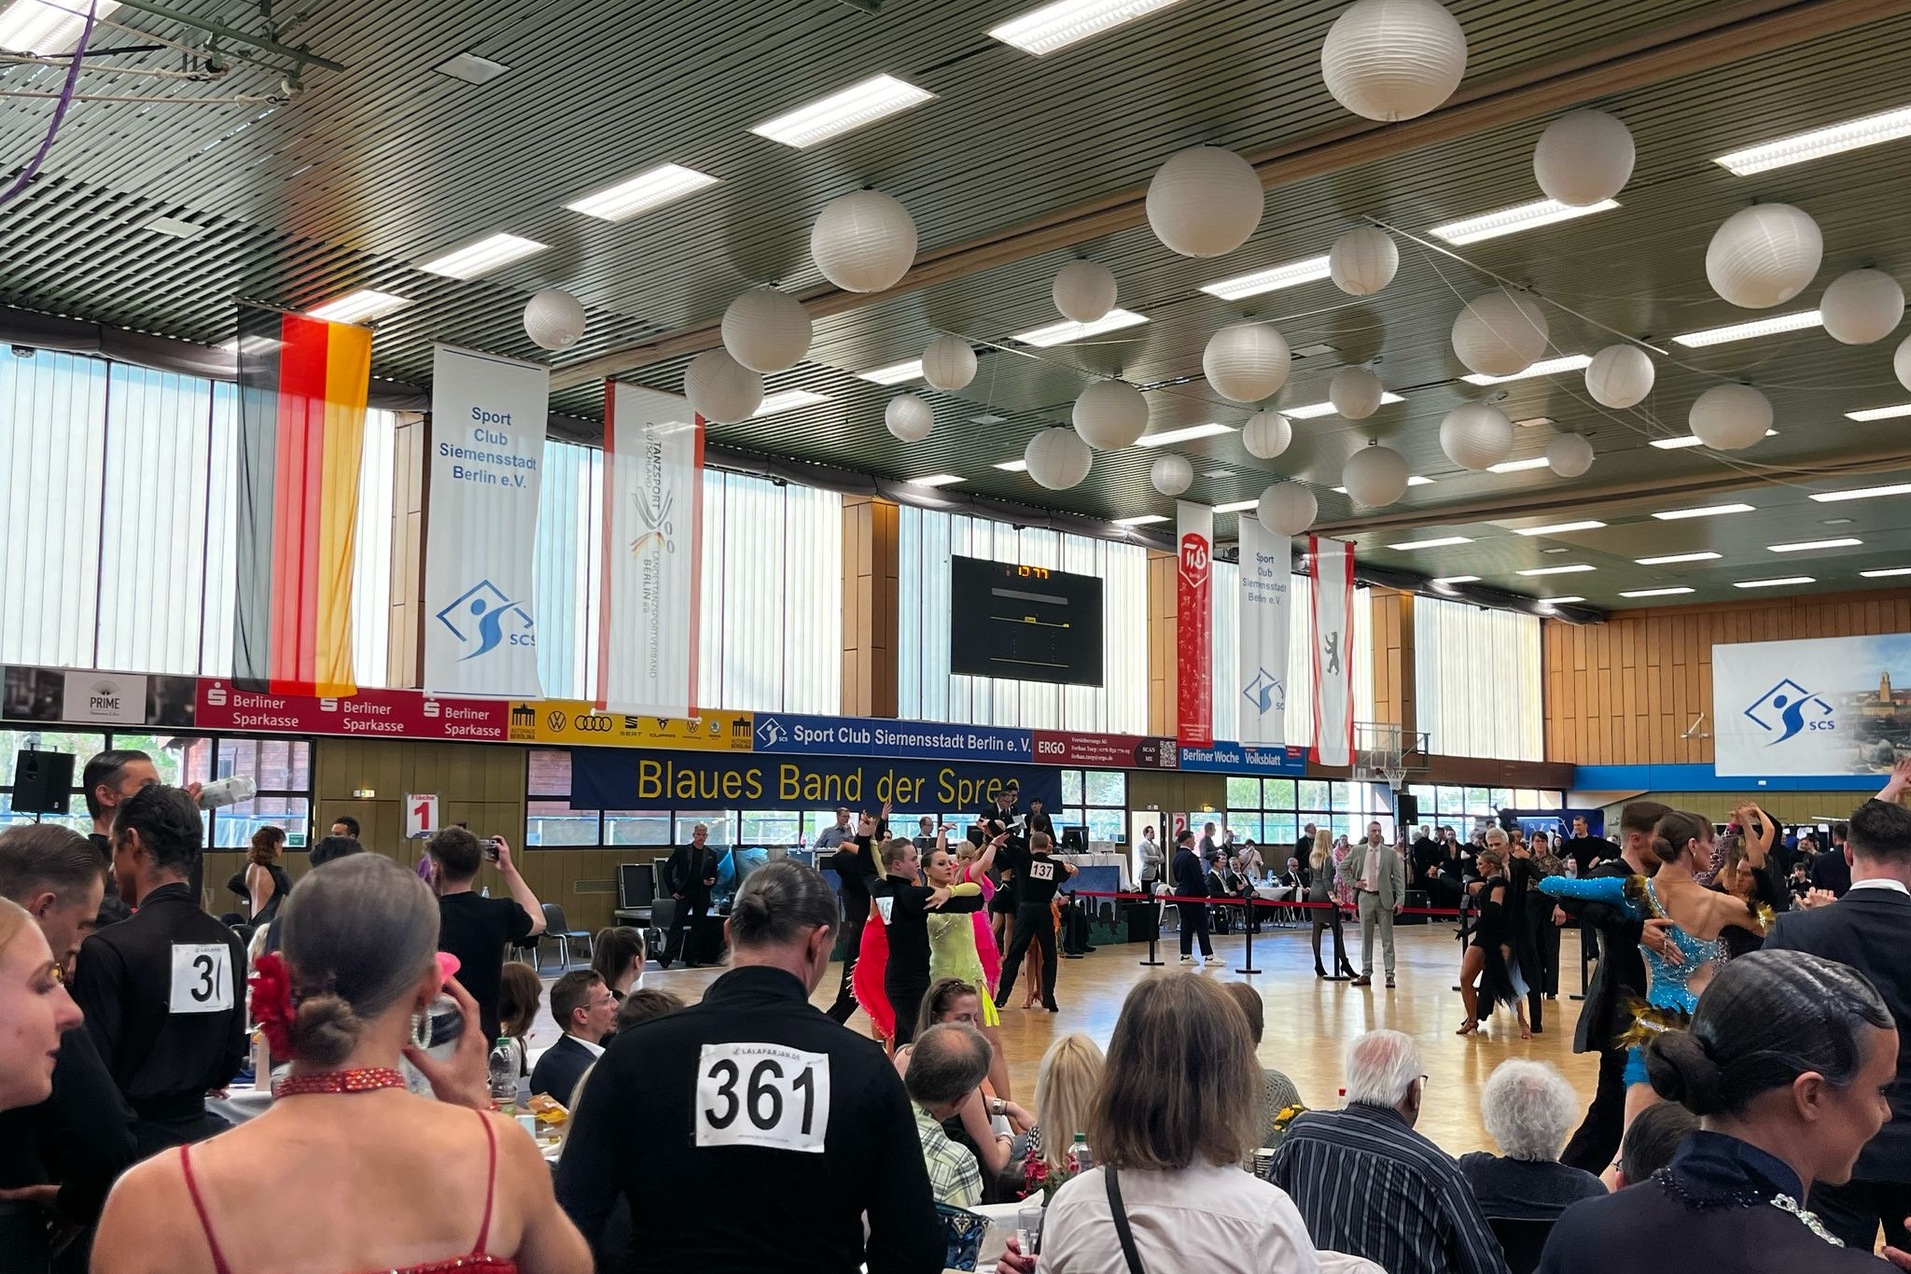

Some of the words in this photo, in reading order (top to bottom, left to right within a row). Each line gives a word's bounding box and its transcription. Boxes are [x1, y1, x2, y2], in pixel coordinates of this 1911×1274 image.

[471, 406, 512, 426] Sport
[474, 428, 508, 446] Club
[439, 442, 537, 470] Siemensstadt
[453, 465, 496, 485] Berlin
[501, 474, 527, 488] e.V.
[652, 442, 662, 510] TANZSPORT
[643, 558, 652, 600] BERLIN
[90, 697, 120, 709] PRIME
[233, 694, 286, 709] Berliner
[343, 701, 392, 715] Berliner
[233, 712, 299, 727] Sparkasse
[445, 707, 490, 720] Berliner
[343, 718, 404, 732] Sparkasse
[444, 723, 501, 737] Sparkasse
[1809, 720, 1835, 731] SCS
[793, 725, 834, 745] Sport
[838, 727, 871, 744] Club
[874, 729, 965, 749] Siemensstadt
[967, 735, 1004, 751] Berlin
[1007, 740, 1017, 752] e.
[1021, 738, 1032, 753] V.
[1038, 741, 1066, 755] ERGO
[1183, 749, 1214, 762] Berliner
[1214, 751, 1240, 764] Woche
[1244, 751, 1281, 766] Volksblatt
[638, 760, 763, 800] Blaues
[779, 764, 863, 802] Band
[876, 769, 926, 804] der
[414, 802, 430, 830] 1
[1175, 817, 1185, 837] 2
[1033, 864, 1053, 878] 137
[191, 954, 222, 1003] 3
[705, 1059, 815, 1135] 361
